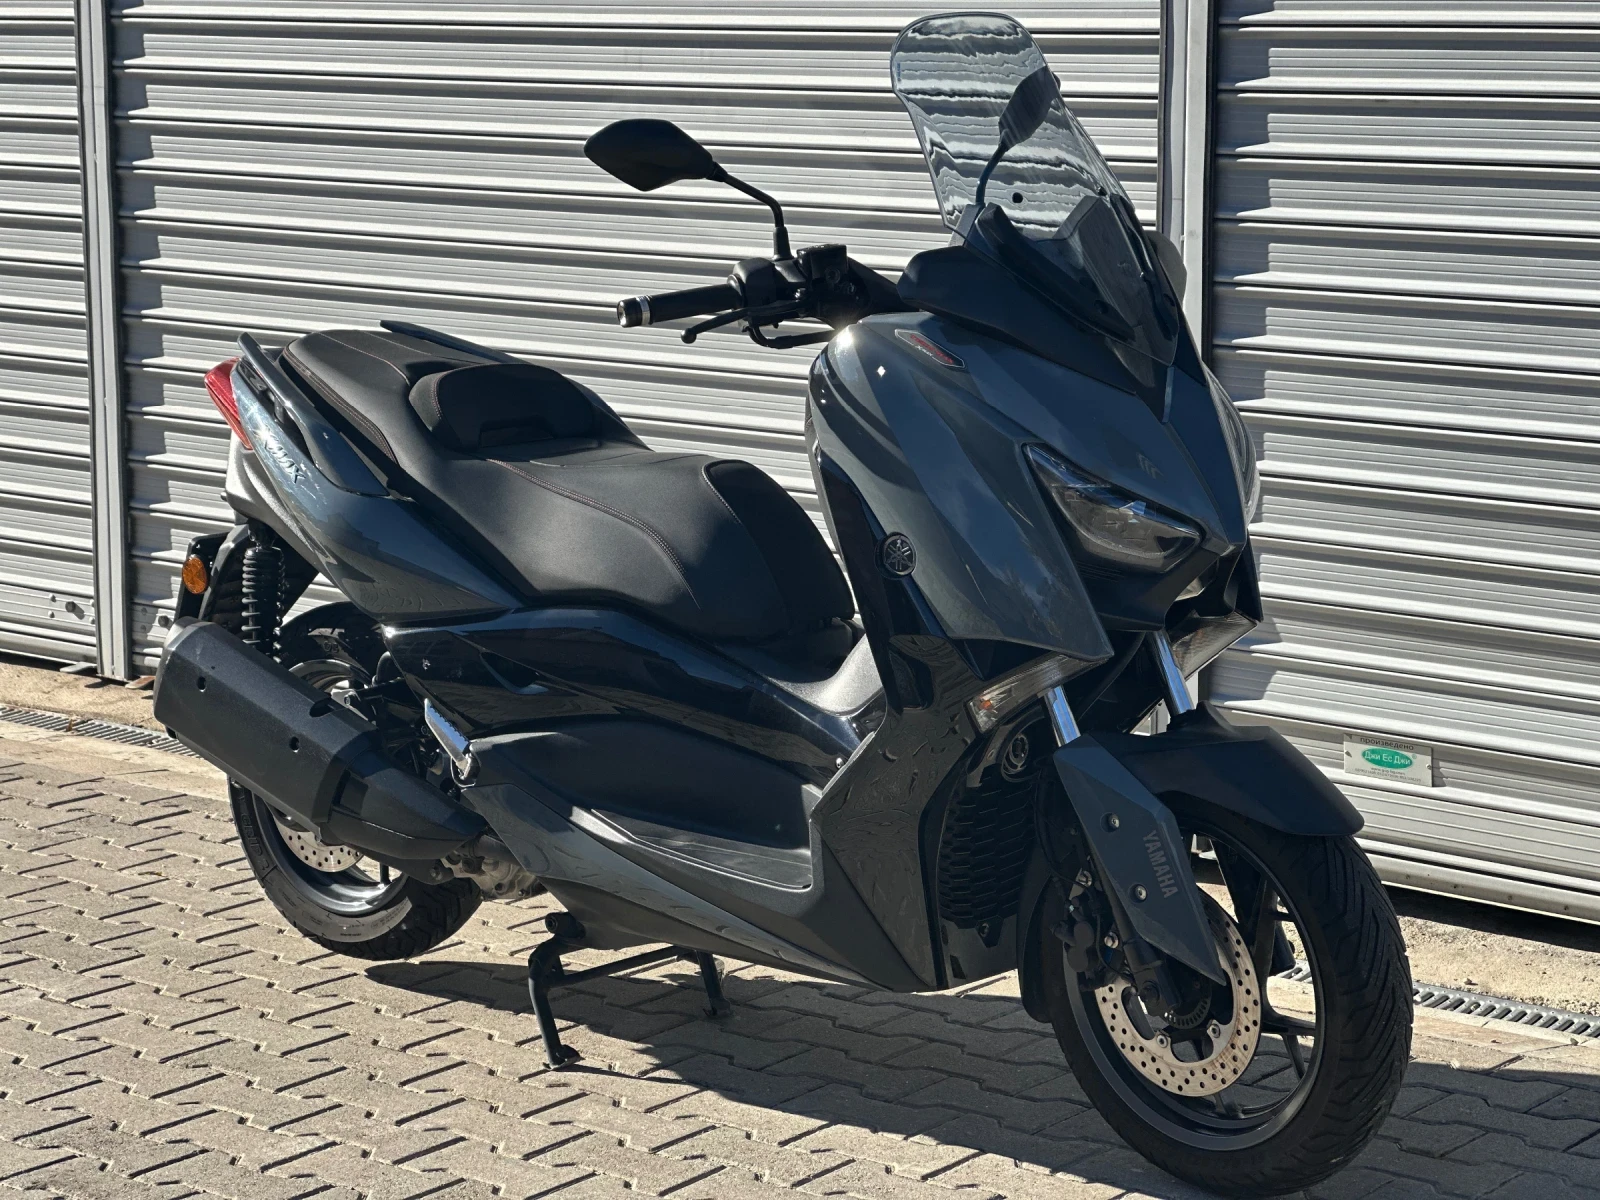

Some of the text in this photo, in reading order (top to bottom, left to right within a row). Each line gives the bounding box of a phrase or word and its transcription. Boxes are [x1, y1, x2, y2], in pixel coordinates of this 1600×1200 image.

[1360, 737, 1414, 751] произведено
[1364, 751, 1411, 765] Джи Ес Джи
[1143, 829, 1179, 898] YAMAHA
